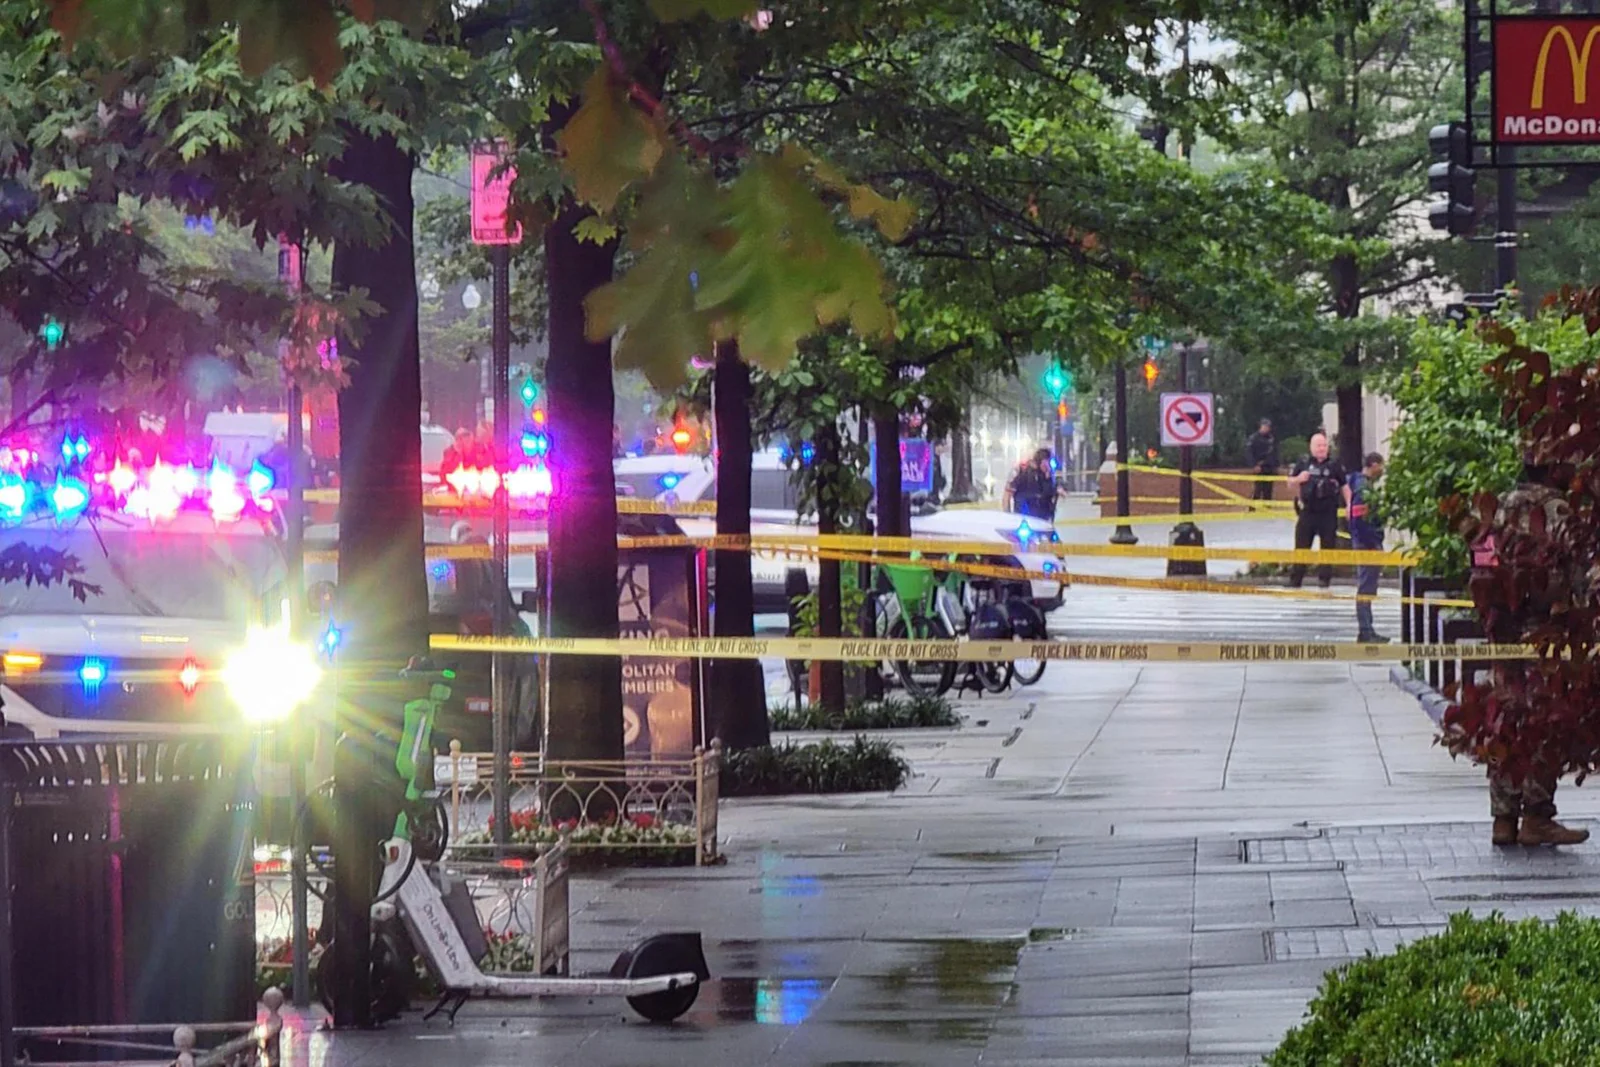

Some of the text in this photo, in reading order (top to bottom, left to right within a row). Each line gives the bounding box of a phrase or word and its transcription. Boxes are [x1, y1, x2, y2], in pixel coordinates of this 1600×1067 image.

[649, 638, 768, 654] POLICE LINE DO NOT CROSS
[840, 642, 959, 659] POLICE LINE DO NOT CROSS
[1031, 644, 1148, 660] POLICE LINE DO NOT CROSS
[1220, 644, 1337, 660] POLICE LINE DO NOT CROSS
[1408, 645, 1437, 657] POLICE
[1440, 645, 1458, 657] LINE
[1461, 645, 1474, 657] DO
[1475, 645, 1492, 657] NOT
[622, 663, 676, 678] OLITAN
[622, 679, 675, 694] MBERS
